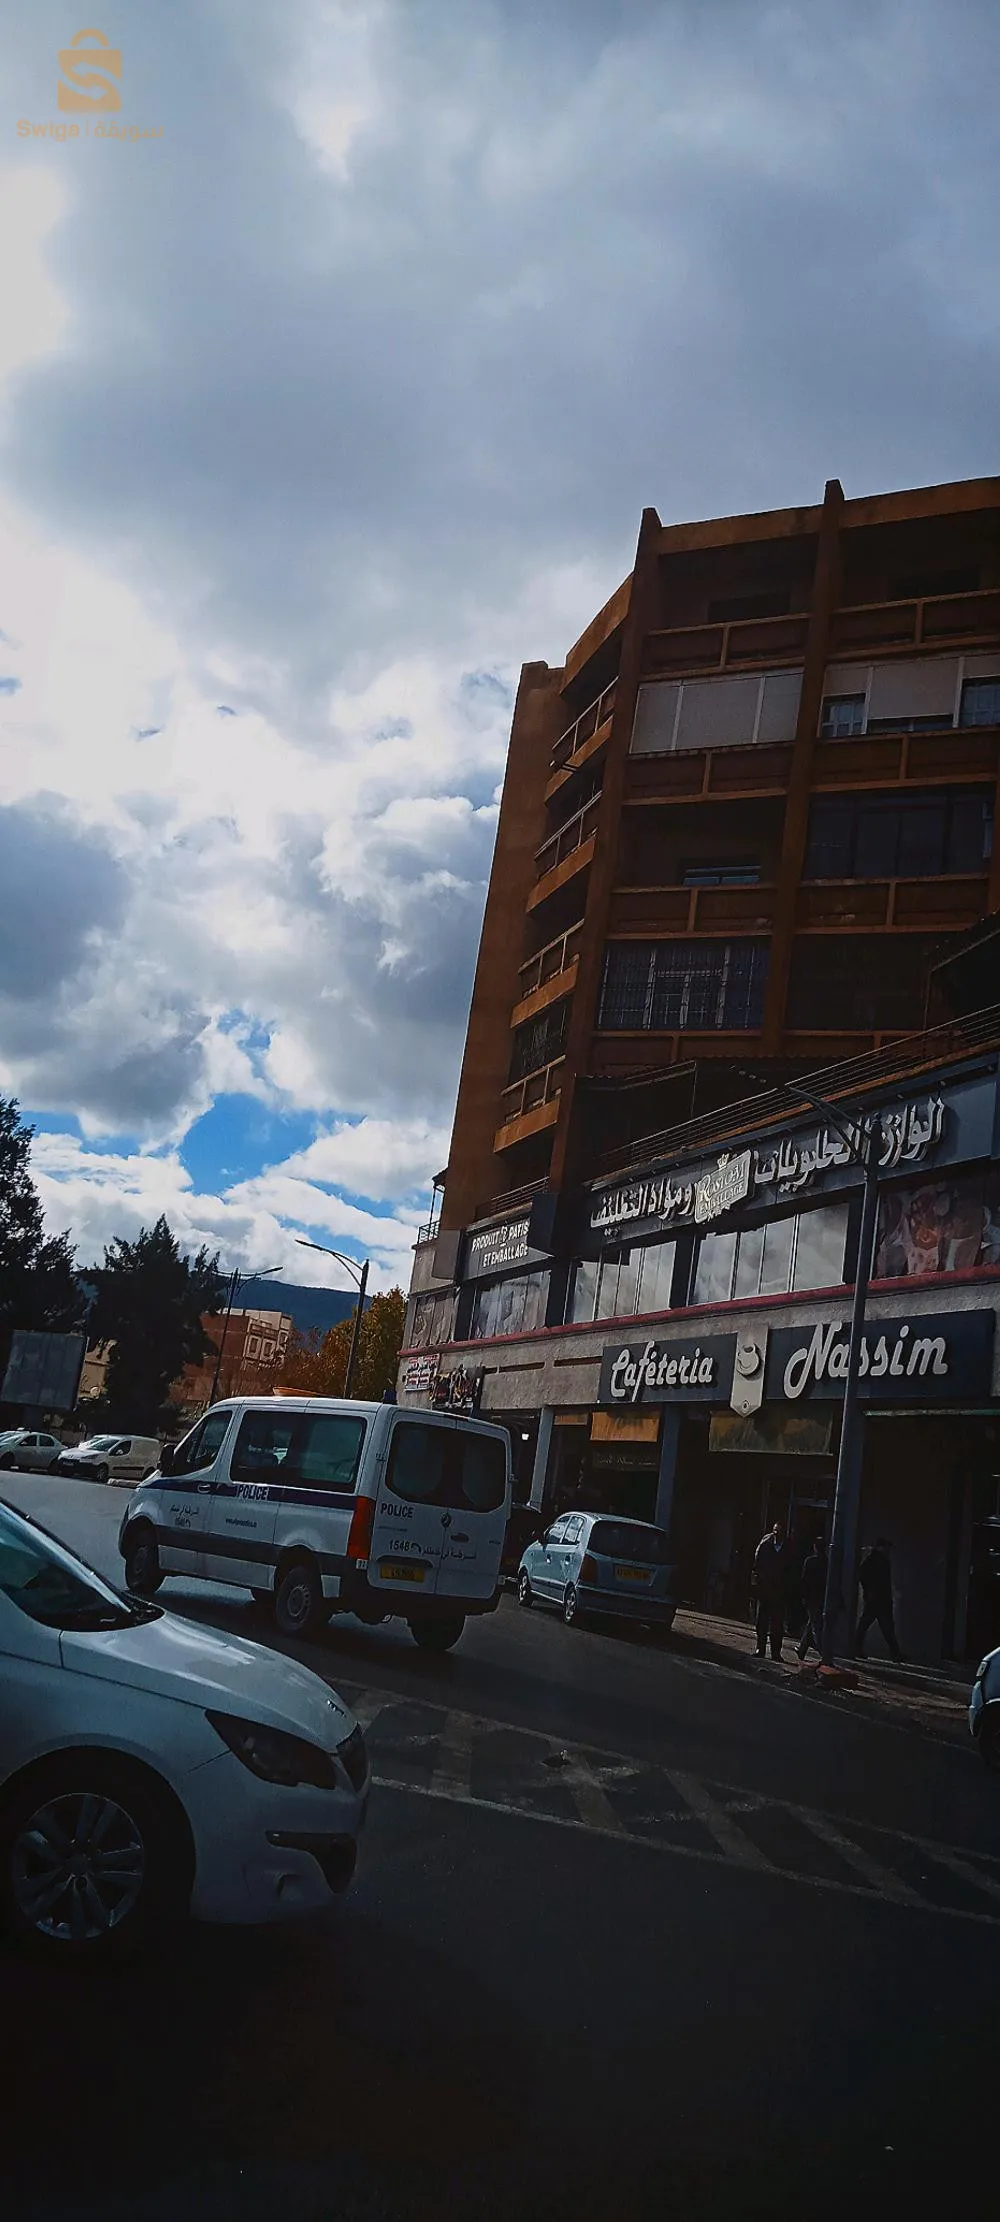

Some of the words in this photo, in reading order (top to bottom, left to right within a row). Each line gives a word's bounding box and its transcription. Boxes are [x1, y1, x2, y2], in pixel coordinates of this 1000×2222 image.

[471, 1230, 500, 1253] PRODUIT
[483, 1252, 492, 1268] ET
[490, 1242, 529, 1265] EMBALLAGE
[610, 1340, 713, 1403] Caféteria
[783, 1320, 949, 1399] Nassim
[238, 1484, 269, 1501] POLICE
[380, 1502, 415, 1519] POLICE
